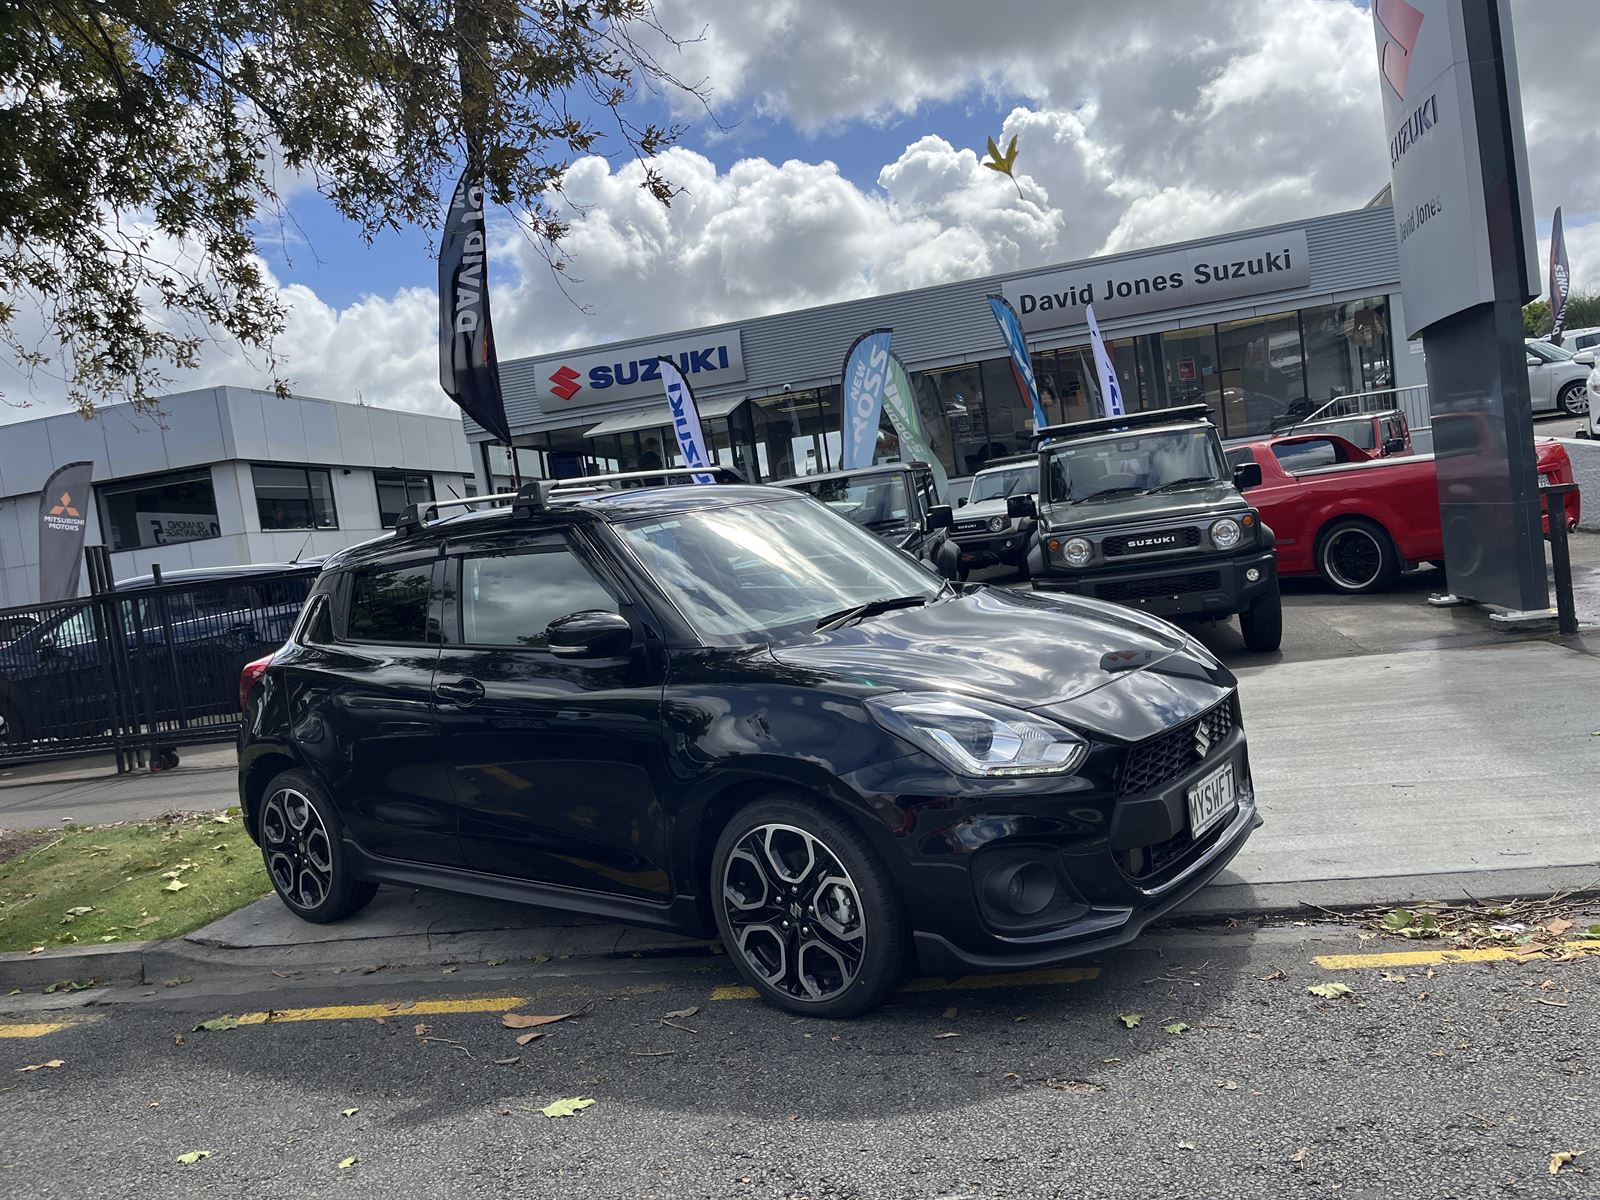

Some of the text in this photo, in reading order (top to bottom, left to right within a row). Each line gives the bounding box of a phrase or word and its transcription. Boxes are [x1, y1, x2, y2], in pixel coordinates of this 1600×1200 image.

[1416, 194, 1443, 229] Jones
[1020, 249, 1292, 315] David Jones Suzuki
[588, 346, 729, 390] SUZUKI
[850, 359, 867, 401] NEW
[853, 344, 888, 460] ROSS
[43, 516, 85, 526] MITSUBISHI
[48, 522, 80, 532] MOTORS
[1127, 536, 1175, 547] SUZUKI
[1189, 769, 1232, 828] MYSWFT
